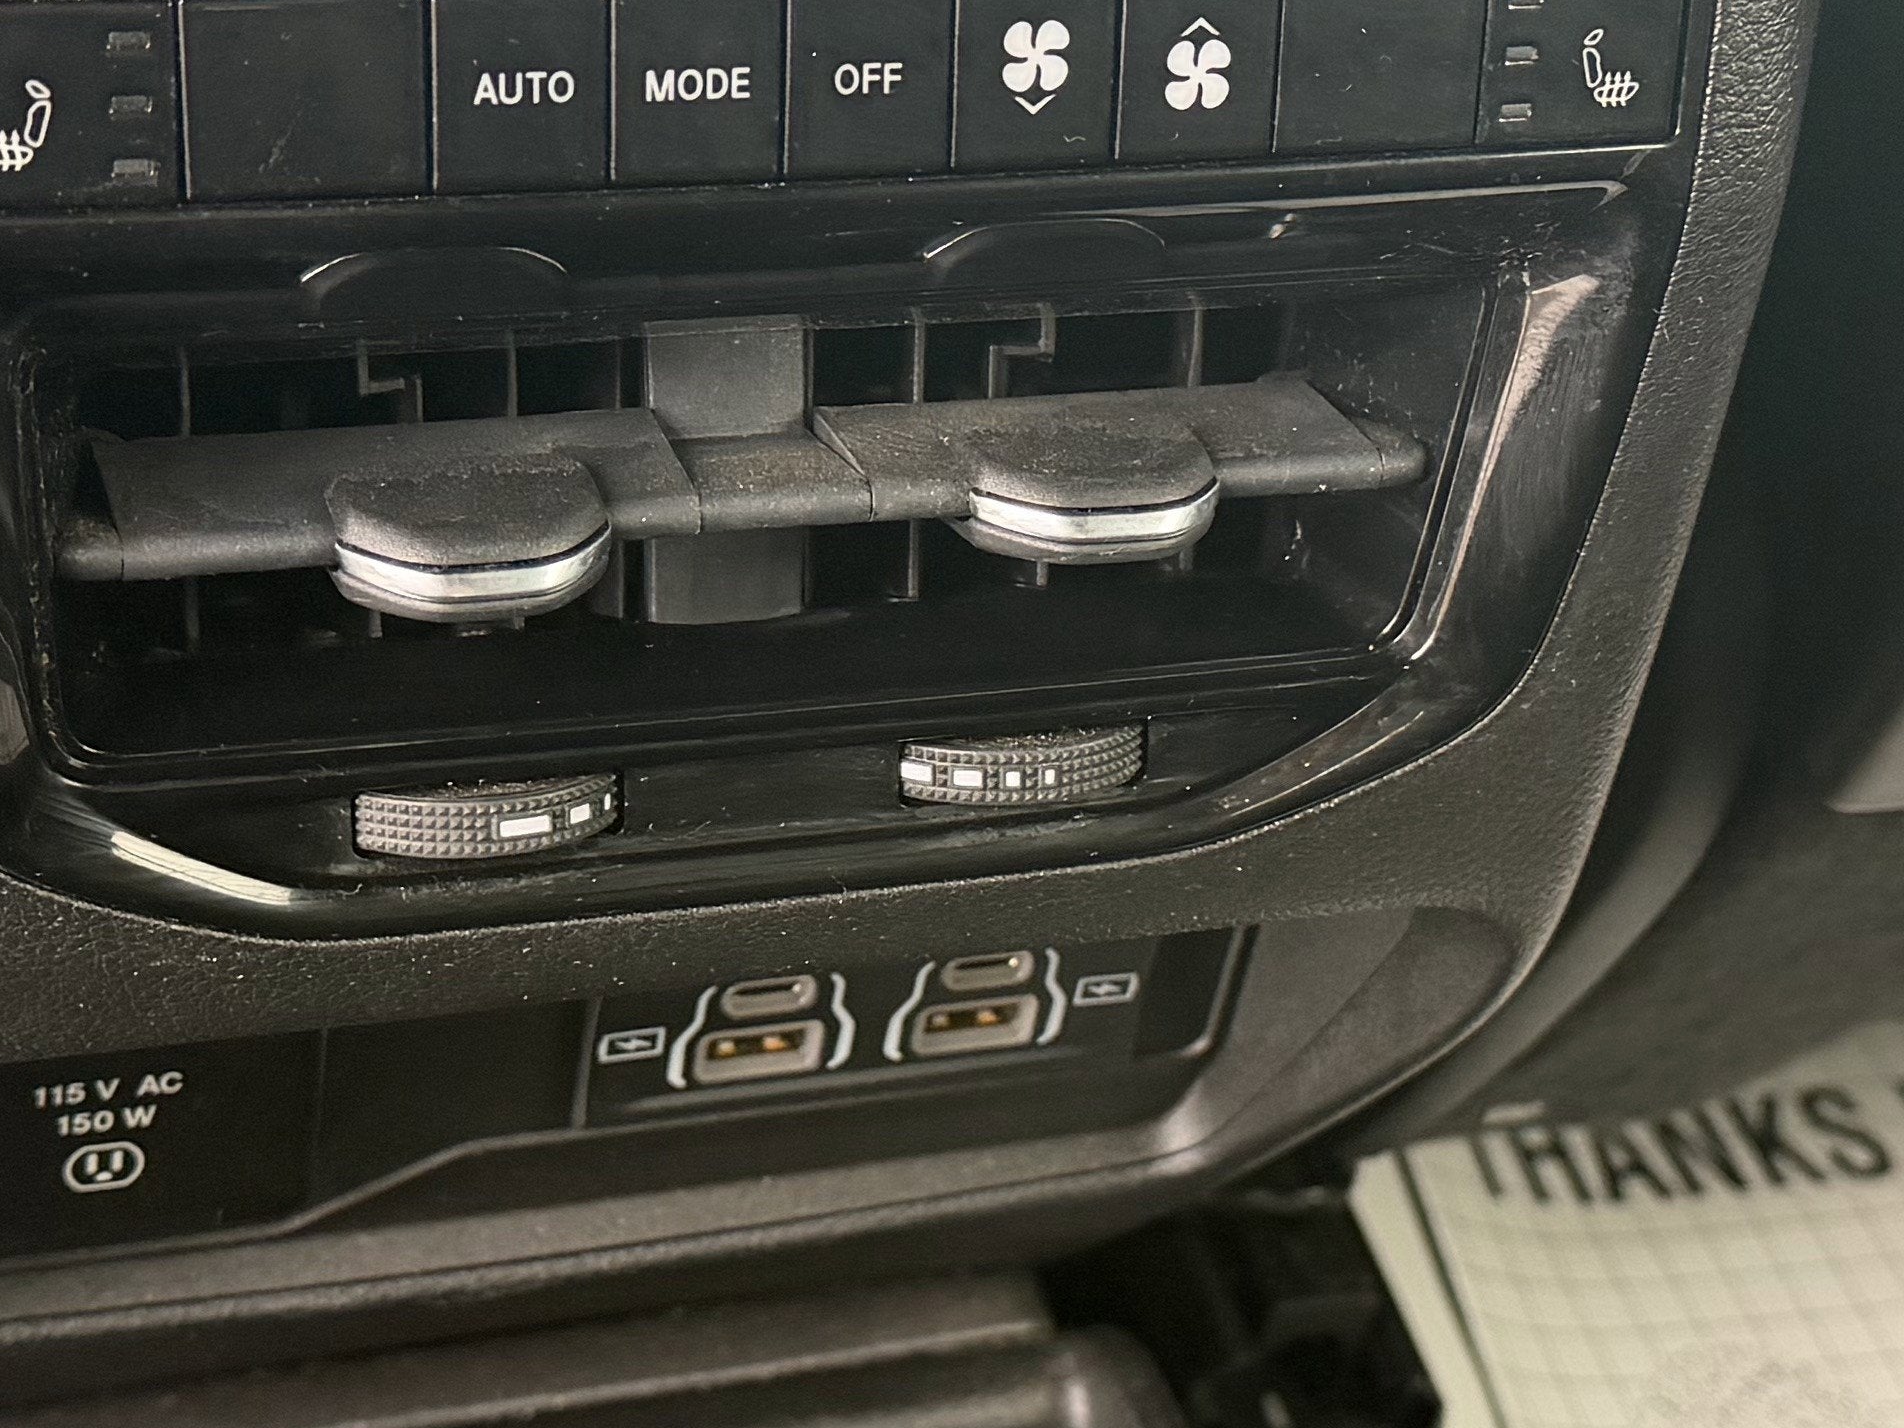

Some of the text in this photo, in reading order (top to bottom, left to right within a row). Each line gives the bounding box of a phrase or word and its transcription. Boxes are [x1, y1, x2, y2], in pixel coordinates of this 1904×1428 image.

[473, 62, 903, 106] AUTO MODE OFF
[33, 1070, 185, 1109] 115 V AC
[56, 1104, 159, 1138] 150 W
